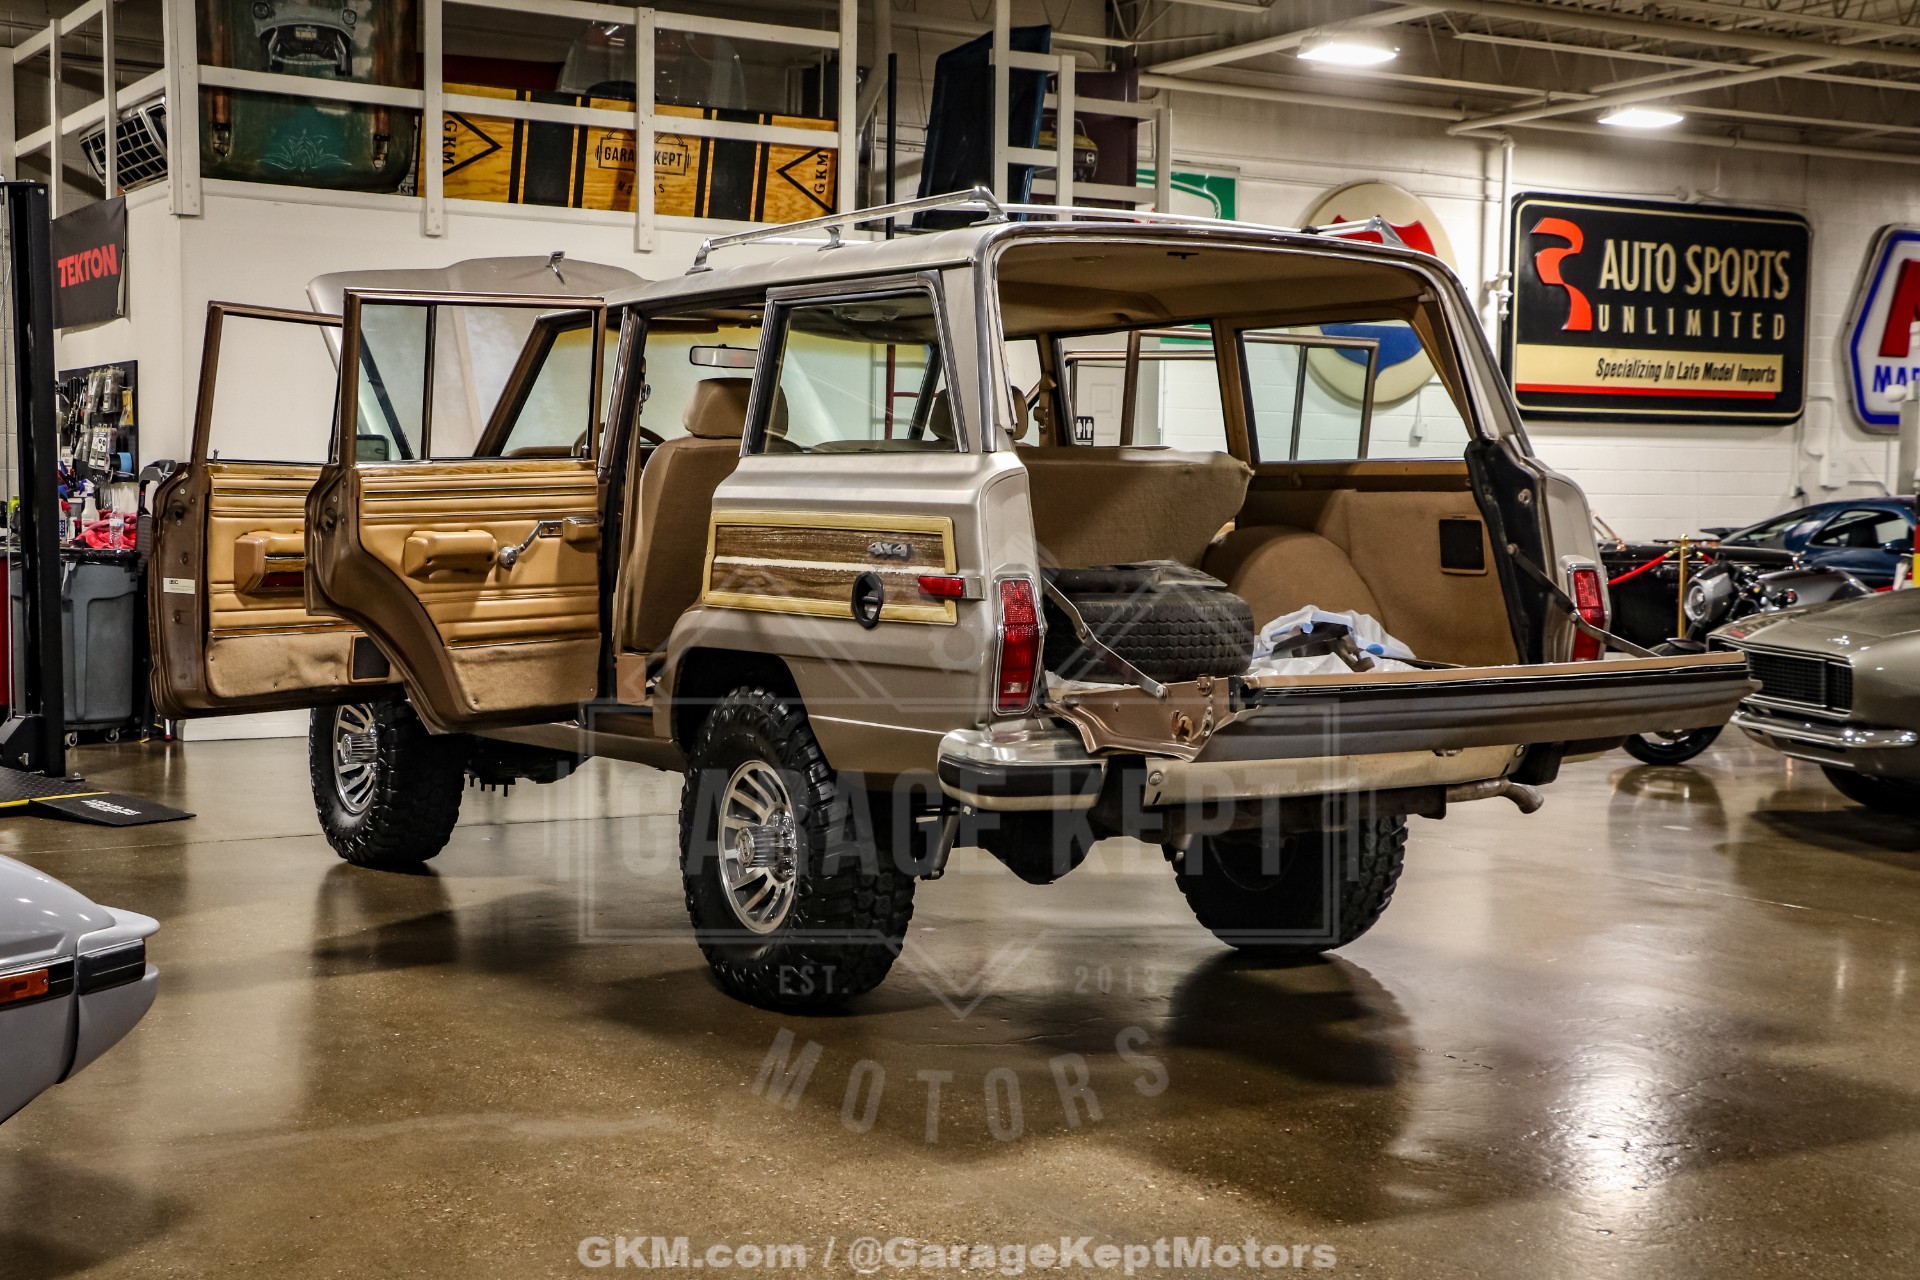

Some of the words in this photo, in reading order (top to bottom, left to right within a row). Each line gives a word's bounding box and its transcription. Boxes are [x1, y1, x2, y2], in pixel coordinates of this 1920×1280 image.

[604, 147, 636, 162] GARA
[814, 153, 829, 194] GKM
[57, 243, 118, 288] TEKTON
[1599, 239, 1676, 293] AUTO
[1685, 244, 1790, 300] SPORTS
[1598, 304, 1785, 340] UNLIMITED
[1596, 358, 1662, 382] Specializing
[1664, 361, 1675, 379] In
[1676, 361, 1700, 380] Late
[1702, 362, 1736, 382] Model
[1737, 364, 1776, 385] Imports
